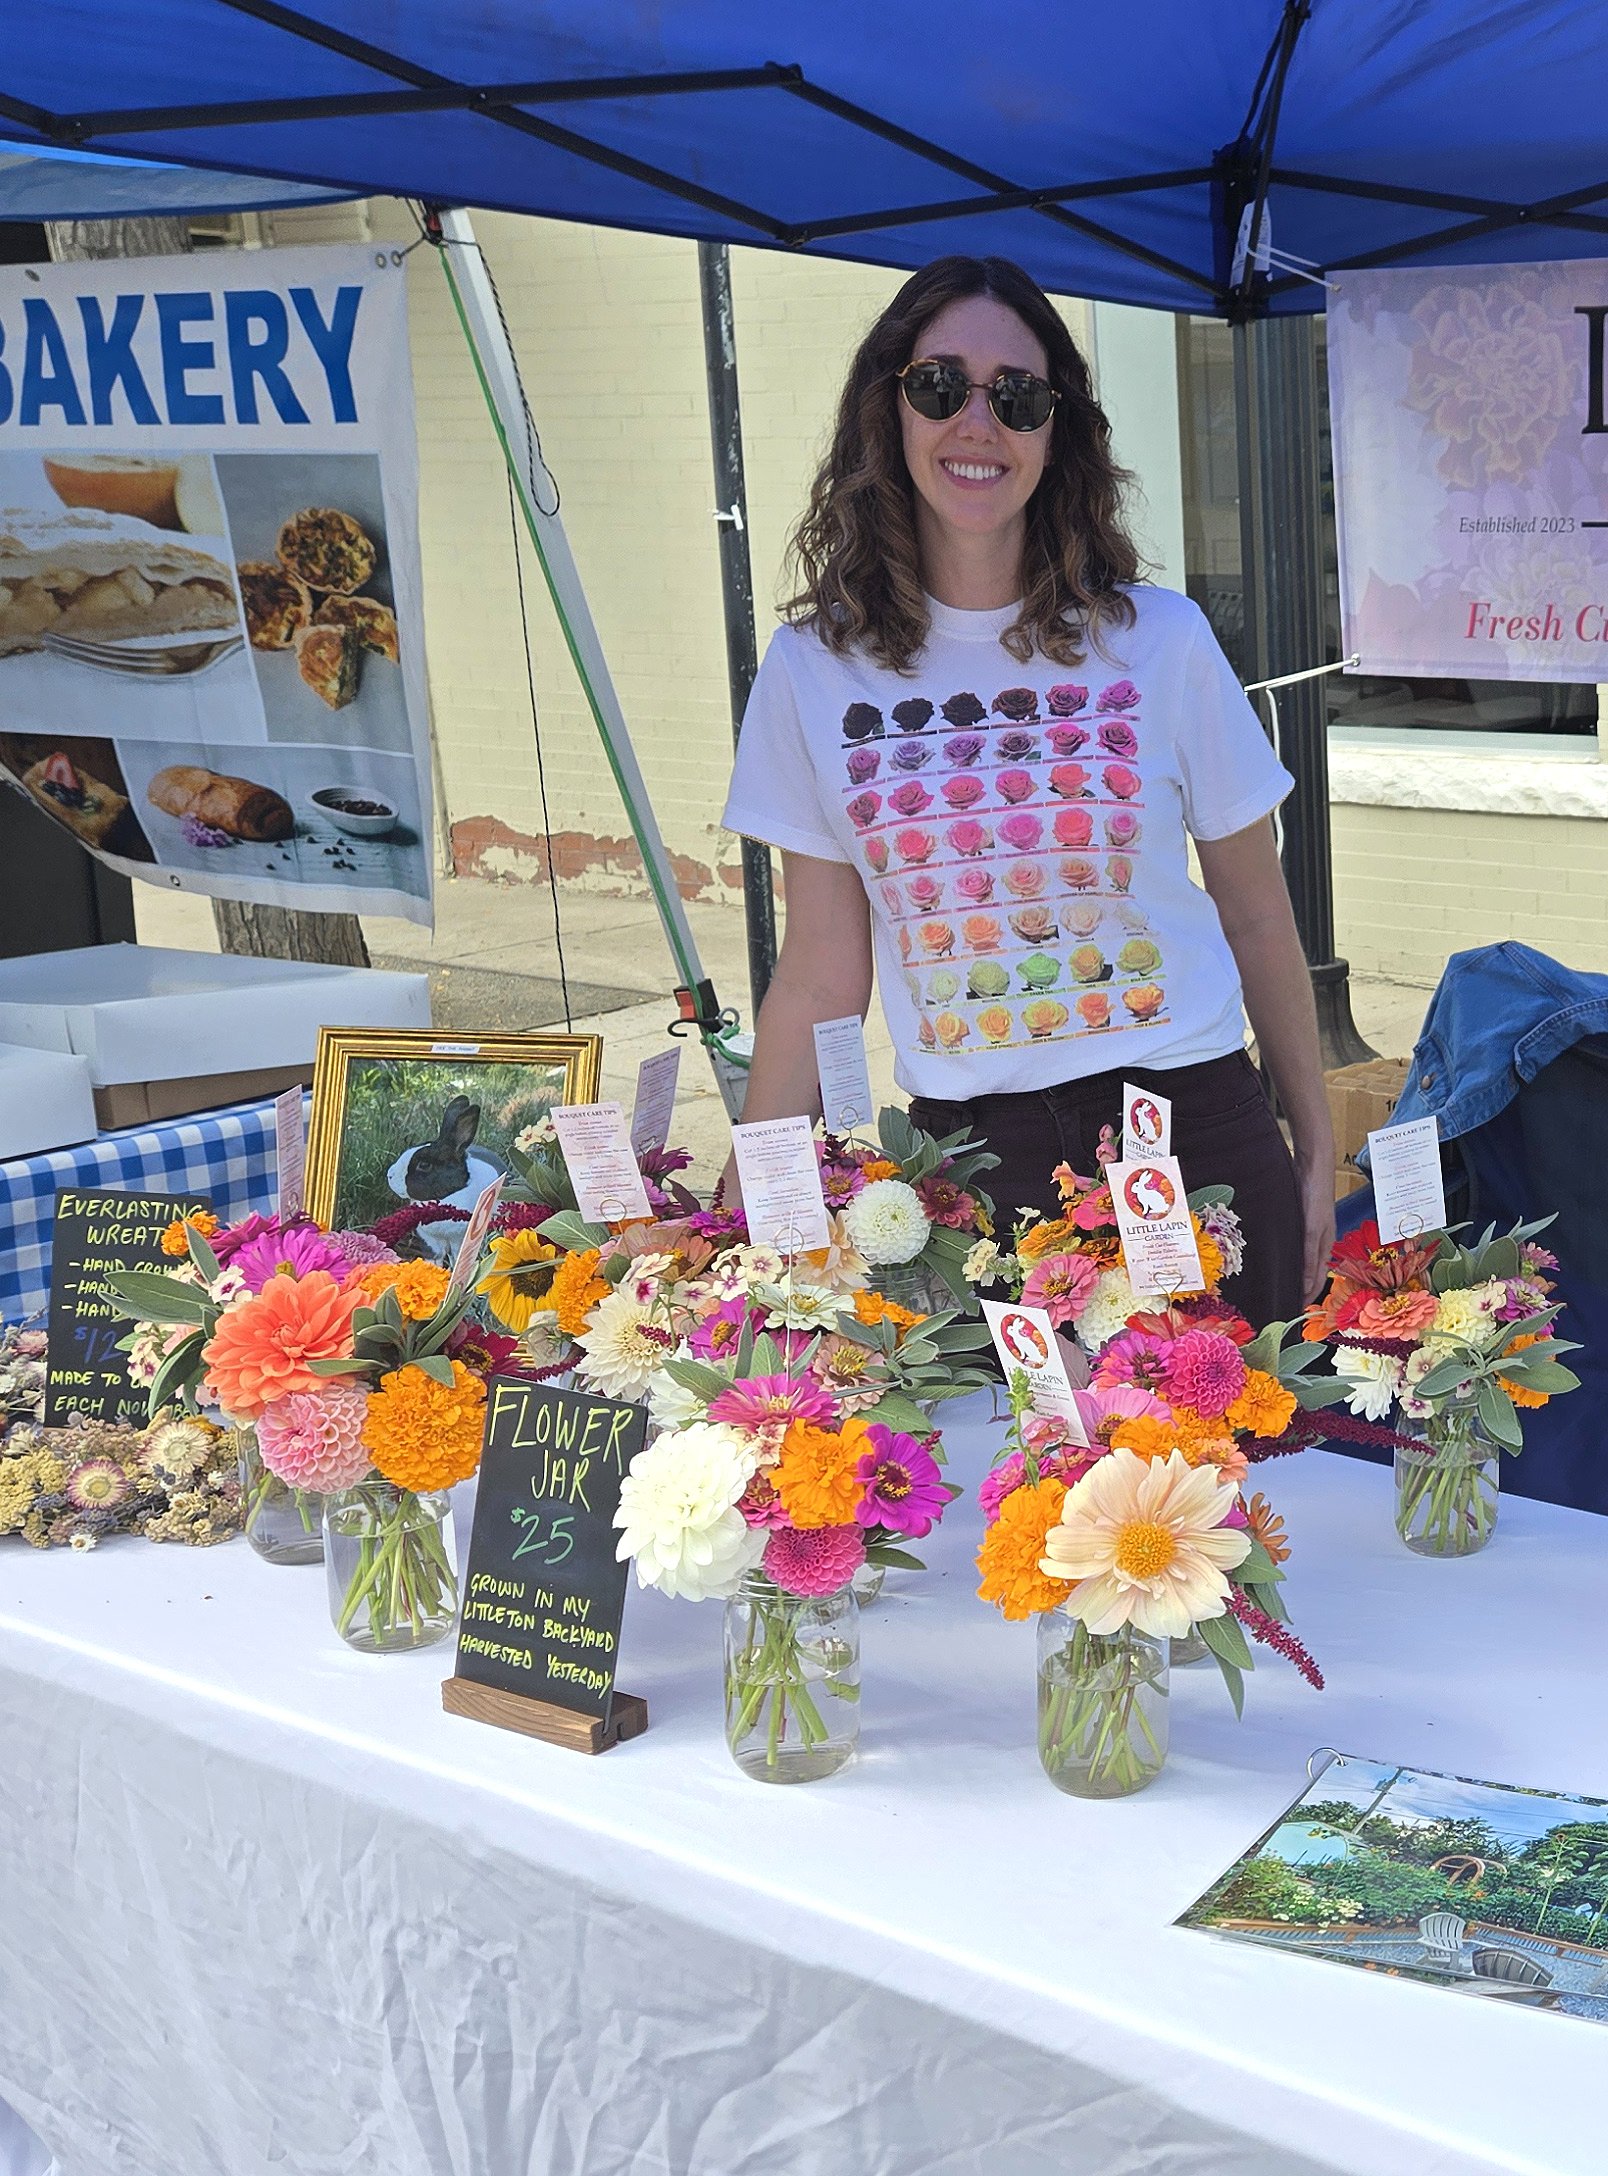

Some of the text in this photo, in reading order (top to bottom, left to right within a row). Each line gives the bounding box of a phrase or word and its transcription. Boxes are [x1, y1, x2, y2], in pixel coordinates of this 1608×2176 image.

[0, 287, 363, 426] AKERY
[1459, 516, 1576, 534] Established 2023
[1463, 602, 1563, 642] Fresh
[558, 1111, 587, 1120] BOUQUET
[587, 1110, 604, 1118] CARE
[741, 1124, 807, 1139] BOUQUET CARE TIPS
[1375, 1132, 1403, 1144] BOUQUET
[1402, 1128, 1418, 1137] CARE
[1126, 1138, 1145, 1153] LITTLE
[87, 1223, 166, 1247] WREAT
[1126, 1221, 1189, 1236] LITTLE LAPIN
[50, 1370, 99, 1387] MADE
[101, 1372, 121, 1387] TO
[1037, 1373, 1064, 1385] LAPIN
[54, 1396, 105, 1416] EACH
[489, 1384, 634, 1475] FLOWER
[531, 1449, 592, 1513] JAR
[510, 1507, 575, 1563] $25
[470, 1573, 592, 1623] GROWN IN MY
[463, 1600, 615, 1654] LITTLETON BACKYARD
[460, 1633, 614, 1700] HARVESTED YESTERDAY
